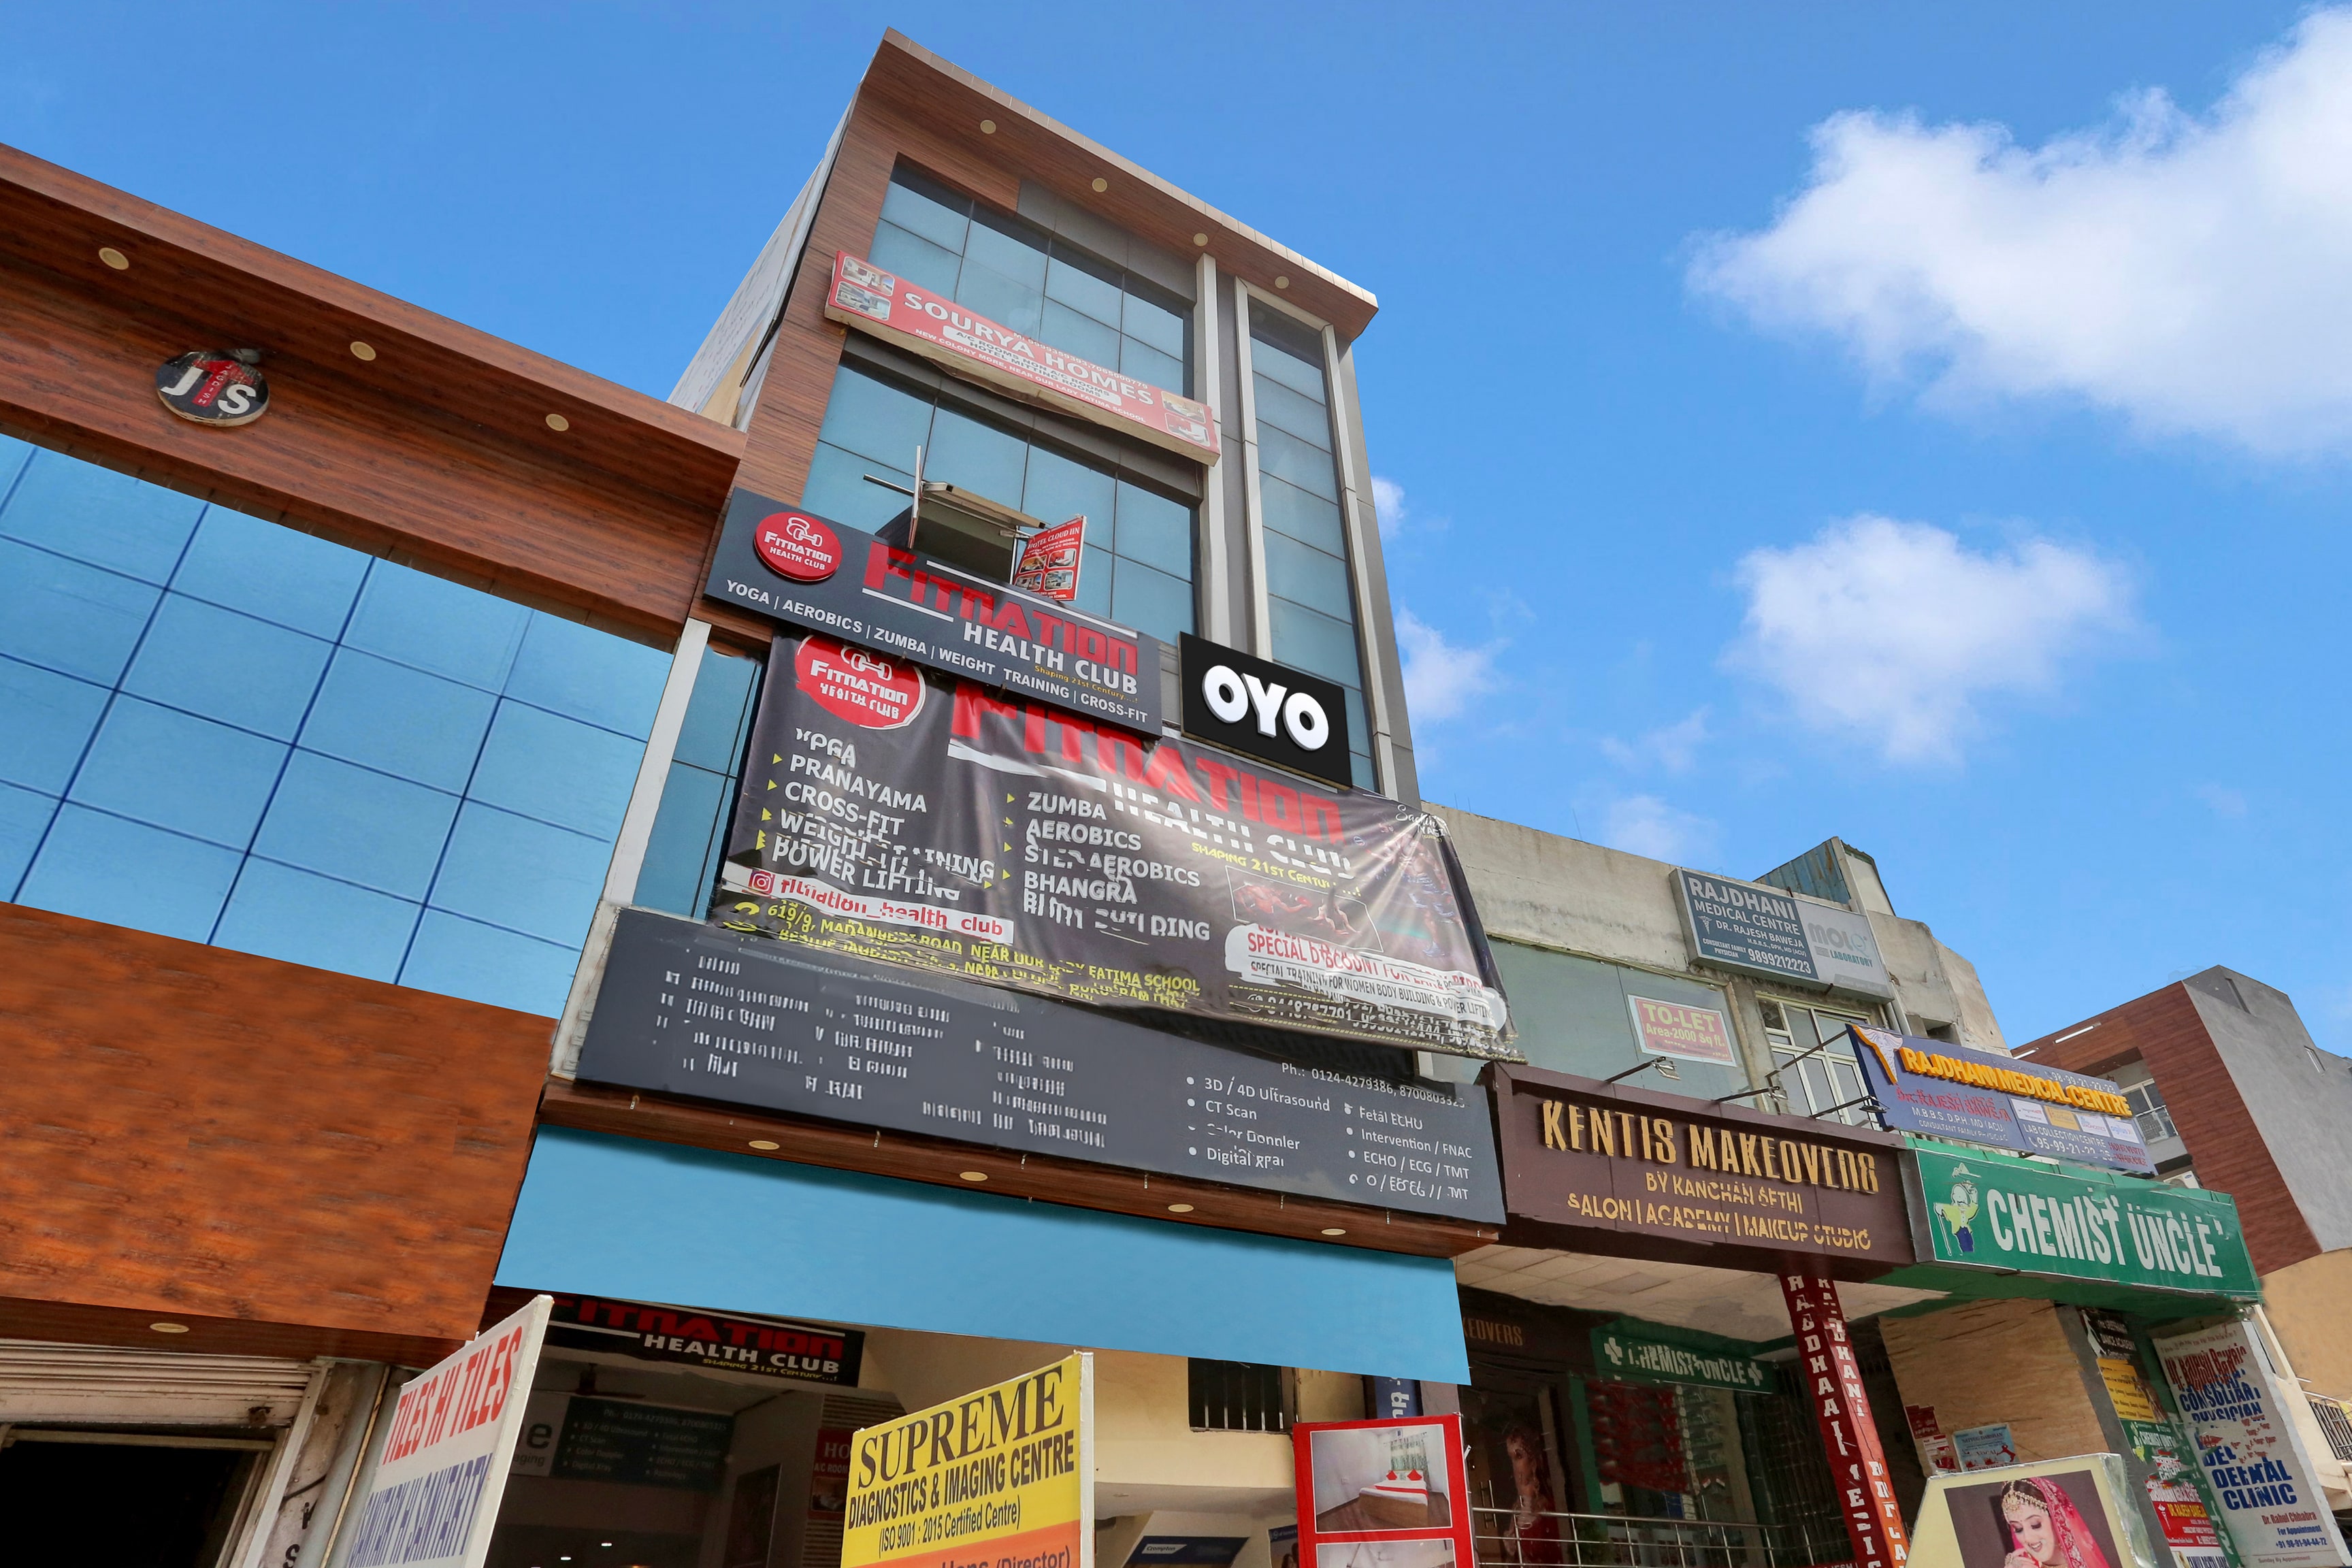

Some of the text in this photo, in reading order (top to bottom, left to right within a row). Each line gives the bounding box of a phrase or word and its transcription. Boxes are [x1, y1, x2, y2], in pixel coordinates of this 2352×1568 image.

[904, 293, 1154, 405] SOURYA HOMES
[956, 331, 1110, 396] A/C ROOMS NON A/C ROOMS
[915, 329, 936, 340] NEW
[939, 338, 976, 355] COLONY
[1009, 365, 1033, 378] NEAR
[1035, 376, 1054, 387] OUR
[1056, 384, 1078, 395] LADY
[1080, 393, 1110, 407] FATIMA
[1113, 407, 1146, 422] SCHOOL
[970, 342, 1101, 397] HOTEL MITTING ROOMS
[1048, 530, 1069, 542] CLOUD
[770, 546, 826, 570] HEALTH CLUB
[727, 579, 1148, 723] YOGA AEROBICS ZUMBA WEIGHT TRAINING CROSS-FIT
[964, 621, 1138, 695] HEALTH CLUB
[1034, 665, 1089, 687] Shaping 21st
[1203, 664, 1329, 751] OYO
[789, 753, 927, 814] PRANAYAMA
[785, 781, 905, 836] CROSS-FIT
[1027, 791, 1107, 821] ZUMBA
[1026, 818, 1142, 851] AEROBICS
[1090, 852, 1201, 887] AEROBICS
[1025, 870, 1137, 905] BHANGRA
[1688, 877, 1797, 921] RAJDHANI
[1694, 899, 1801, 936] MEDICAL CENTRE
[1248, 932, 1307, 962] SPECIAL
[1703, 938, 1747, 953] CONSULTANT FAMILY
[1716, 919, 1805, 949] DR. RAJESH BAWEJA
[1748, 948, 1812, 975] 9899212223
[1784, 946, 1792, 954] MD
[1829, 949, 1873, 968] LABORATORY
[1329, 976, 1343, 990] FOR
[1345, 978, 1375, 995] WOMEN
[1377, 984, 1397, 999] BODY
[1399, 988, 1435, 1006] BUILDING
[1437, 996, 1443, 1006] &
[1643, 1003, 1715, 1032] TO-LET
[1699, 1032, 1713, 1047] Sq
[1205, 1078, 1330, 1112] 3D 4D Ultrasound
[1899, 1047, 1999, 1090] RAJDHANI
[1996, 1067, 2073, 1105] MEDICAL
[2065, 1084, 2133, 1117] CENTRE
[1205, 1100, 1257, 1120] CT Scan
[1359, 1106, 1388, 1123] Fetal
[1911, 1106, 1983, 1128] M.B.B.S. D.P.H. MD
[1918, 1120, 1957, 1133] CONSULTANT
[2023, 1124, 2106, 1148] LAB COLLECTION CENTRE
[1362, 1128, 1431, 1152] Intervention
[1442, 1144, 1473, 1158] FNAC
[1364, 1151, 1396, 1167] ECHO
[1409, 1160, 1432, 1173] ECG
[1443, 1165, 1469, 1179] TMT
[1567, 1192, 1633, 1222] SALON
[1986, 1188, 2223, 1279] CHEMIST UNCLE
[644, 1335, 839, 1373] HEALTH CLUB
[1702, 1358, 1748, 1384] UNCLE
[382, 1326, 523, 1465] TILES HI TILES
[858, 1365, 1064, 1490] SUPREME
[848, 1430, 1074, 1530] DIAGNOSTICS & IMAGING CENTRE
[2222, 1483, 2298, 1511] CLINIC
[879, 1494, 1022, 1558] (ISO 9001 2015 Certified Centre)
[2261, 1512, 2317, 1525] Dr. Rahul Chhabra
[2277, 1524, 2323, 1536] For Appointment
[2282, 1554, 2310, 1563] Appointment
